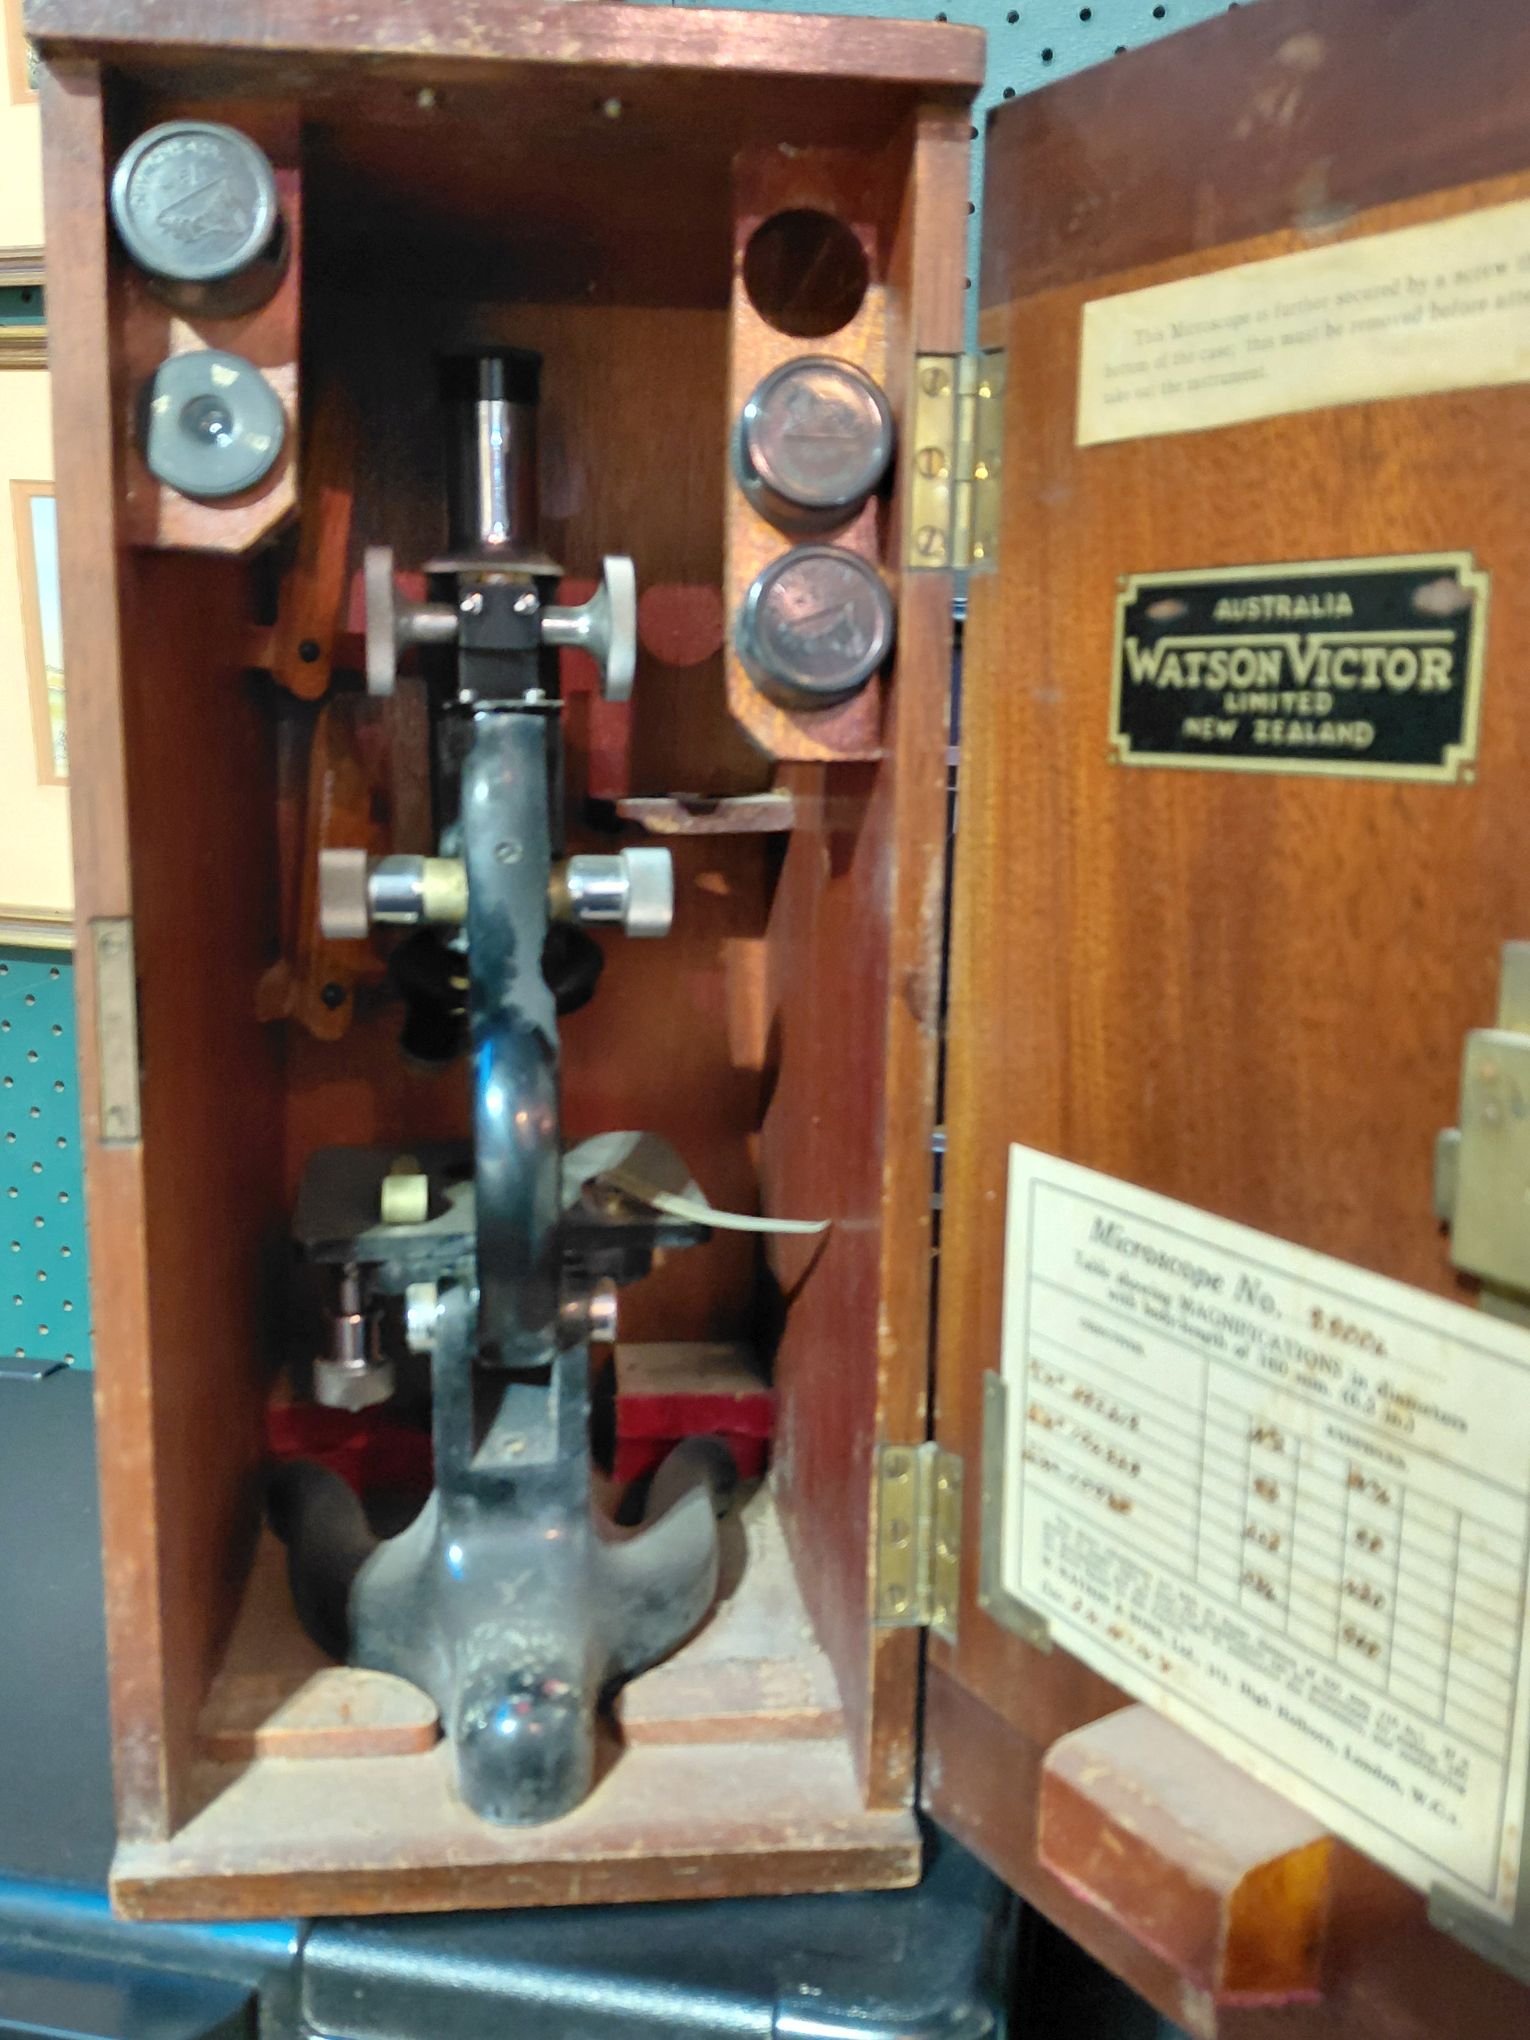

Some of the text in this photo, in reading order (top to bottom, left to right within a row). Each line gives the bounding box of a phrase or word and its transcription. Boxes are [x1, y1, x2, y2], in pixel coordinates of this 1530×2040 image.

[1336, 281, 1400, 306] secured
[1407, 276, 1428, 294] by
[1325, 319, 1343, 338] be
[1213, 591, 1354, 622] AUSTRALIA
[1223, 690, 1334, 716] LIMITED
[1182, 717, 1376, 749] NEW ZEALAND
[1089, 1216, 1225, 1292] Microscope
[1233, 1272, 1282, 1319] No.
[1177, 1294, 1343, 1379] MAGNIFICATIONS
